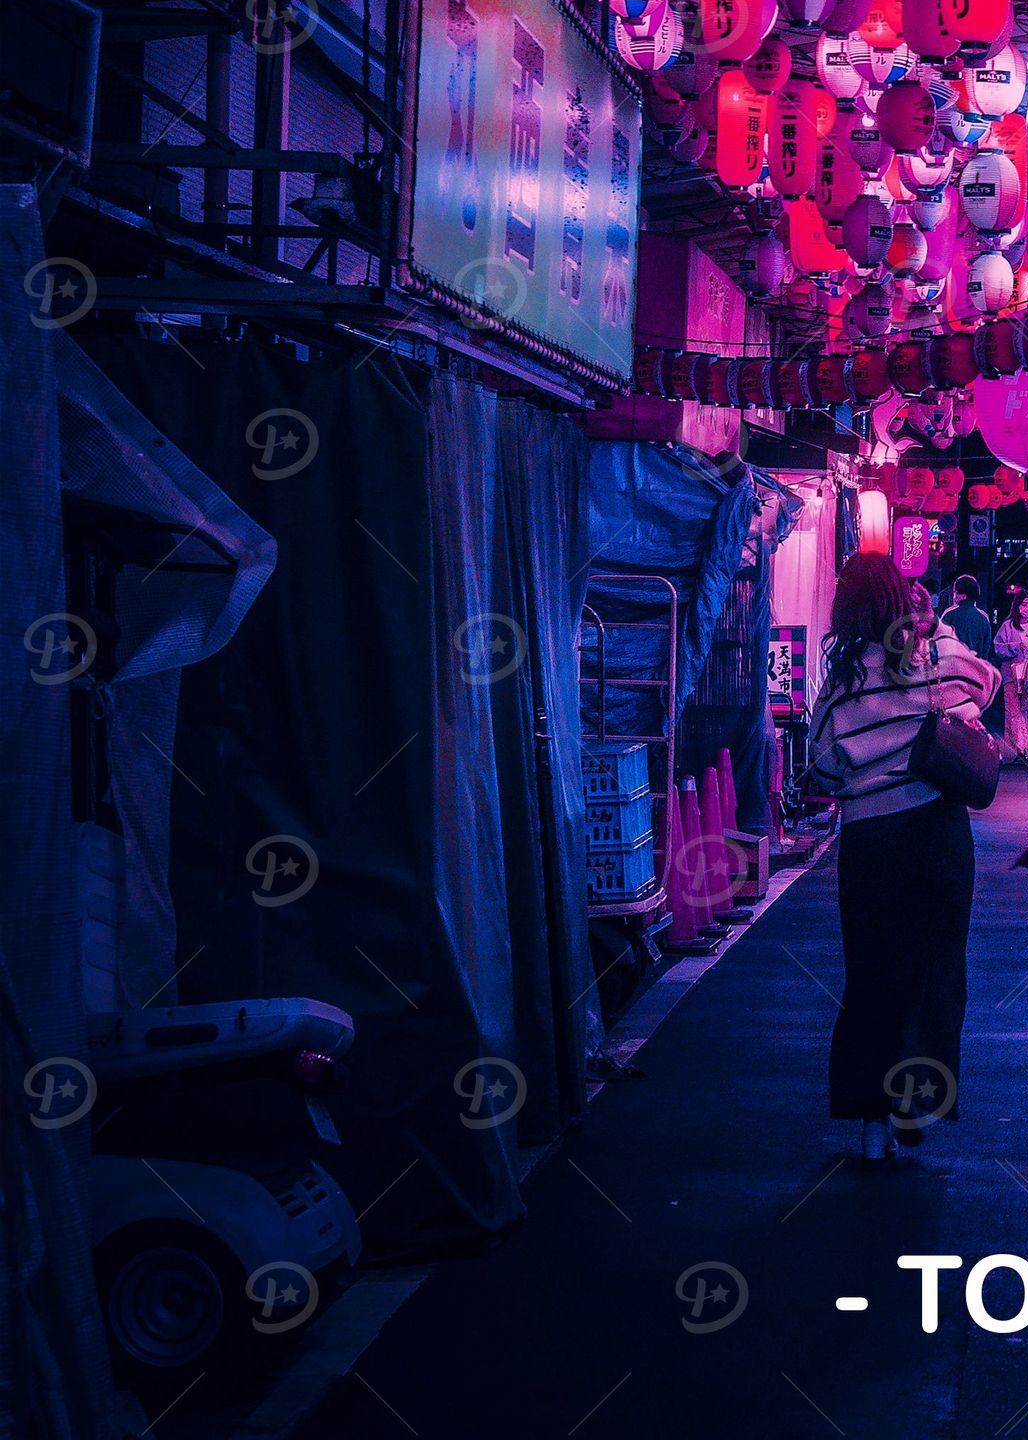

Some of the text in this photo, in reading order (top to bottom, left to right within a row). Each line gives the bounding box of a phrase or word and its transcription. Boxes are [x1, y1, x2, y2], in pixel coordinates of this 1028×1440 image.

[746, 106, 761, 172] 一番搾り
[781, 114, 798, 178] 一番搾り
